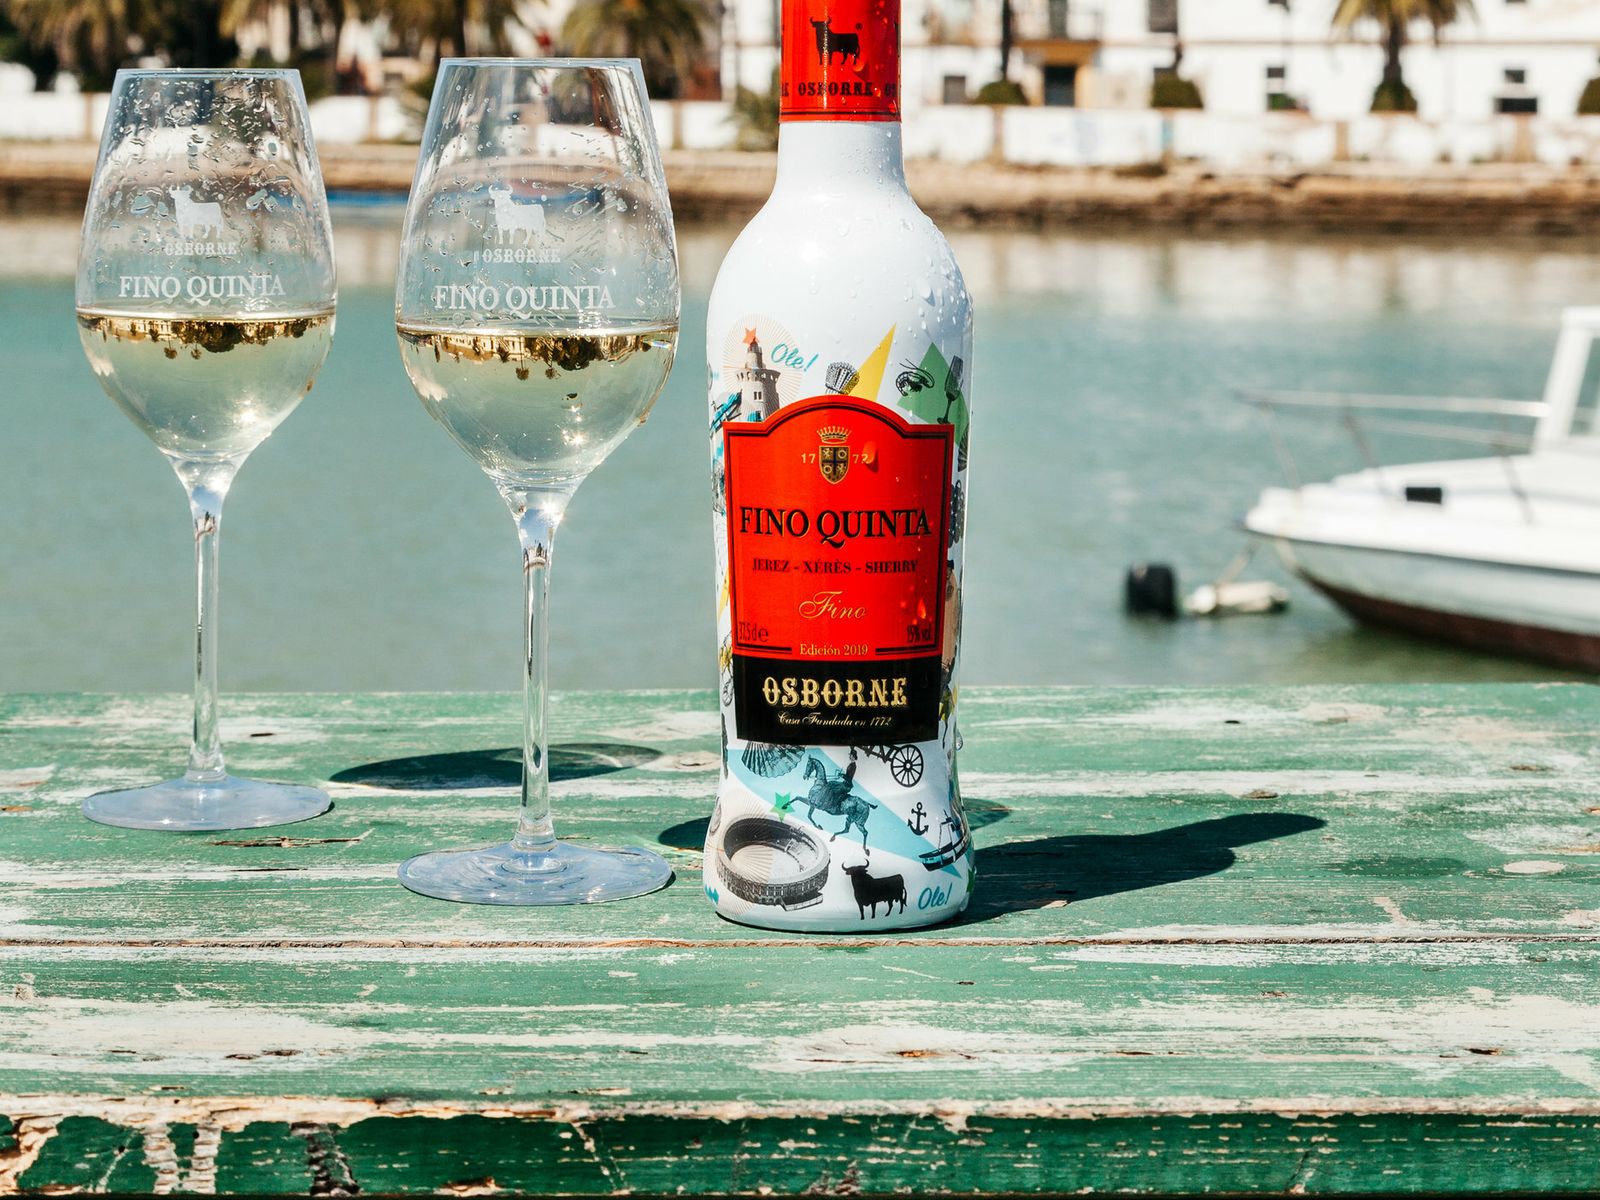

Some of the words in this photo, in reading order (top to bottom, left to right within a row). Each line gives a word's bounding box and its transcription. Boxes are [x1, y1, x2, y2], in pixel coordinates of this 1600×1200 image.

[164, 242, 237, 255] OSBORNE
[481, 248, 560, 263] OSBORNE
[118, 275, 181, 298] FINO
[186, 275, 286, 306] QUINTA
[434, 285, 500, 310] FINO
[505, 285, 616, 319] QUINTA
[770, 343, 819, 372] Ole!
[801, 453, 816, 464] 17
[739, 506, 810, 538] FINO
[816, 508, 932, 549] QUINTA
[752, 558, 790, 572] JEREZ
[803, 558, 851, 574] XÉRÈS
[865, 560, 918, 574] SHERRY
[798, 591, 867, 619] Fino
[800, 643, 841, 656] Edición
[844, 644, 868, 656] 2019
[762, 676, 908, 708] OSBORNE
[778, 711, 800, 726] Casa
[801, 712, 853, 727] Fundada
[869, 716, 892, 727] 1772
[918, 882, 953, 910] Ole!
